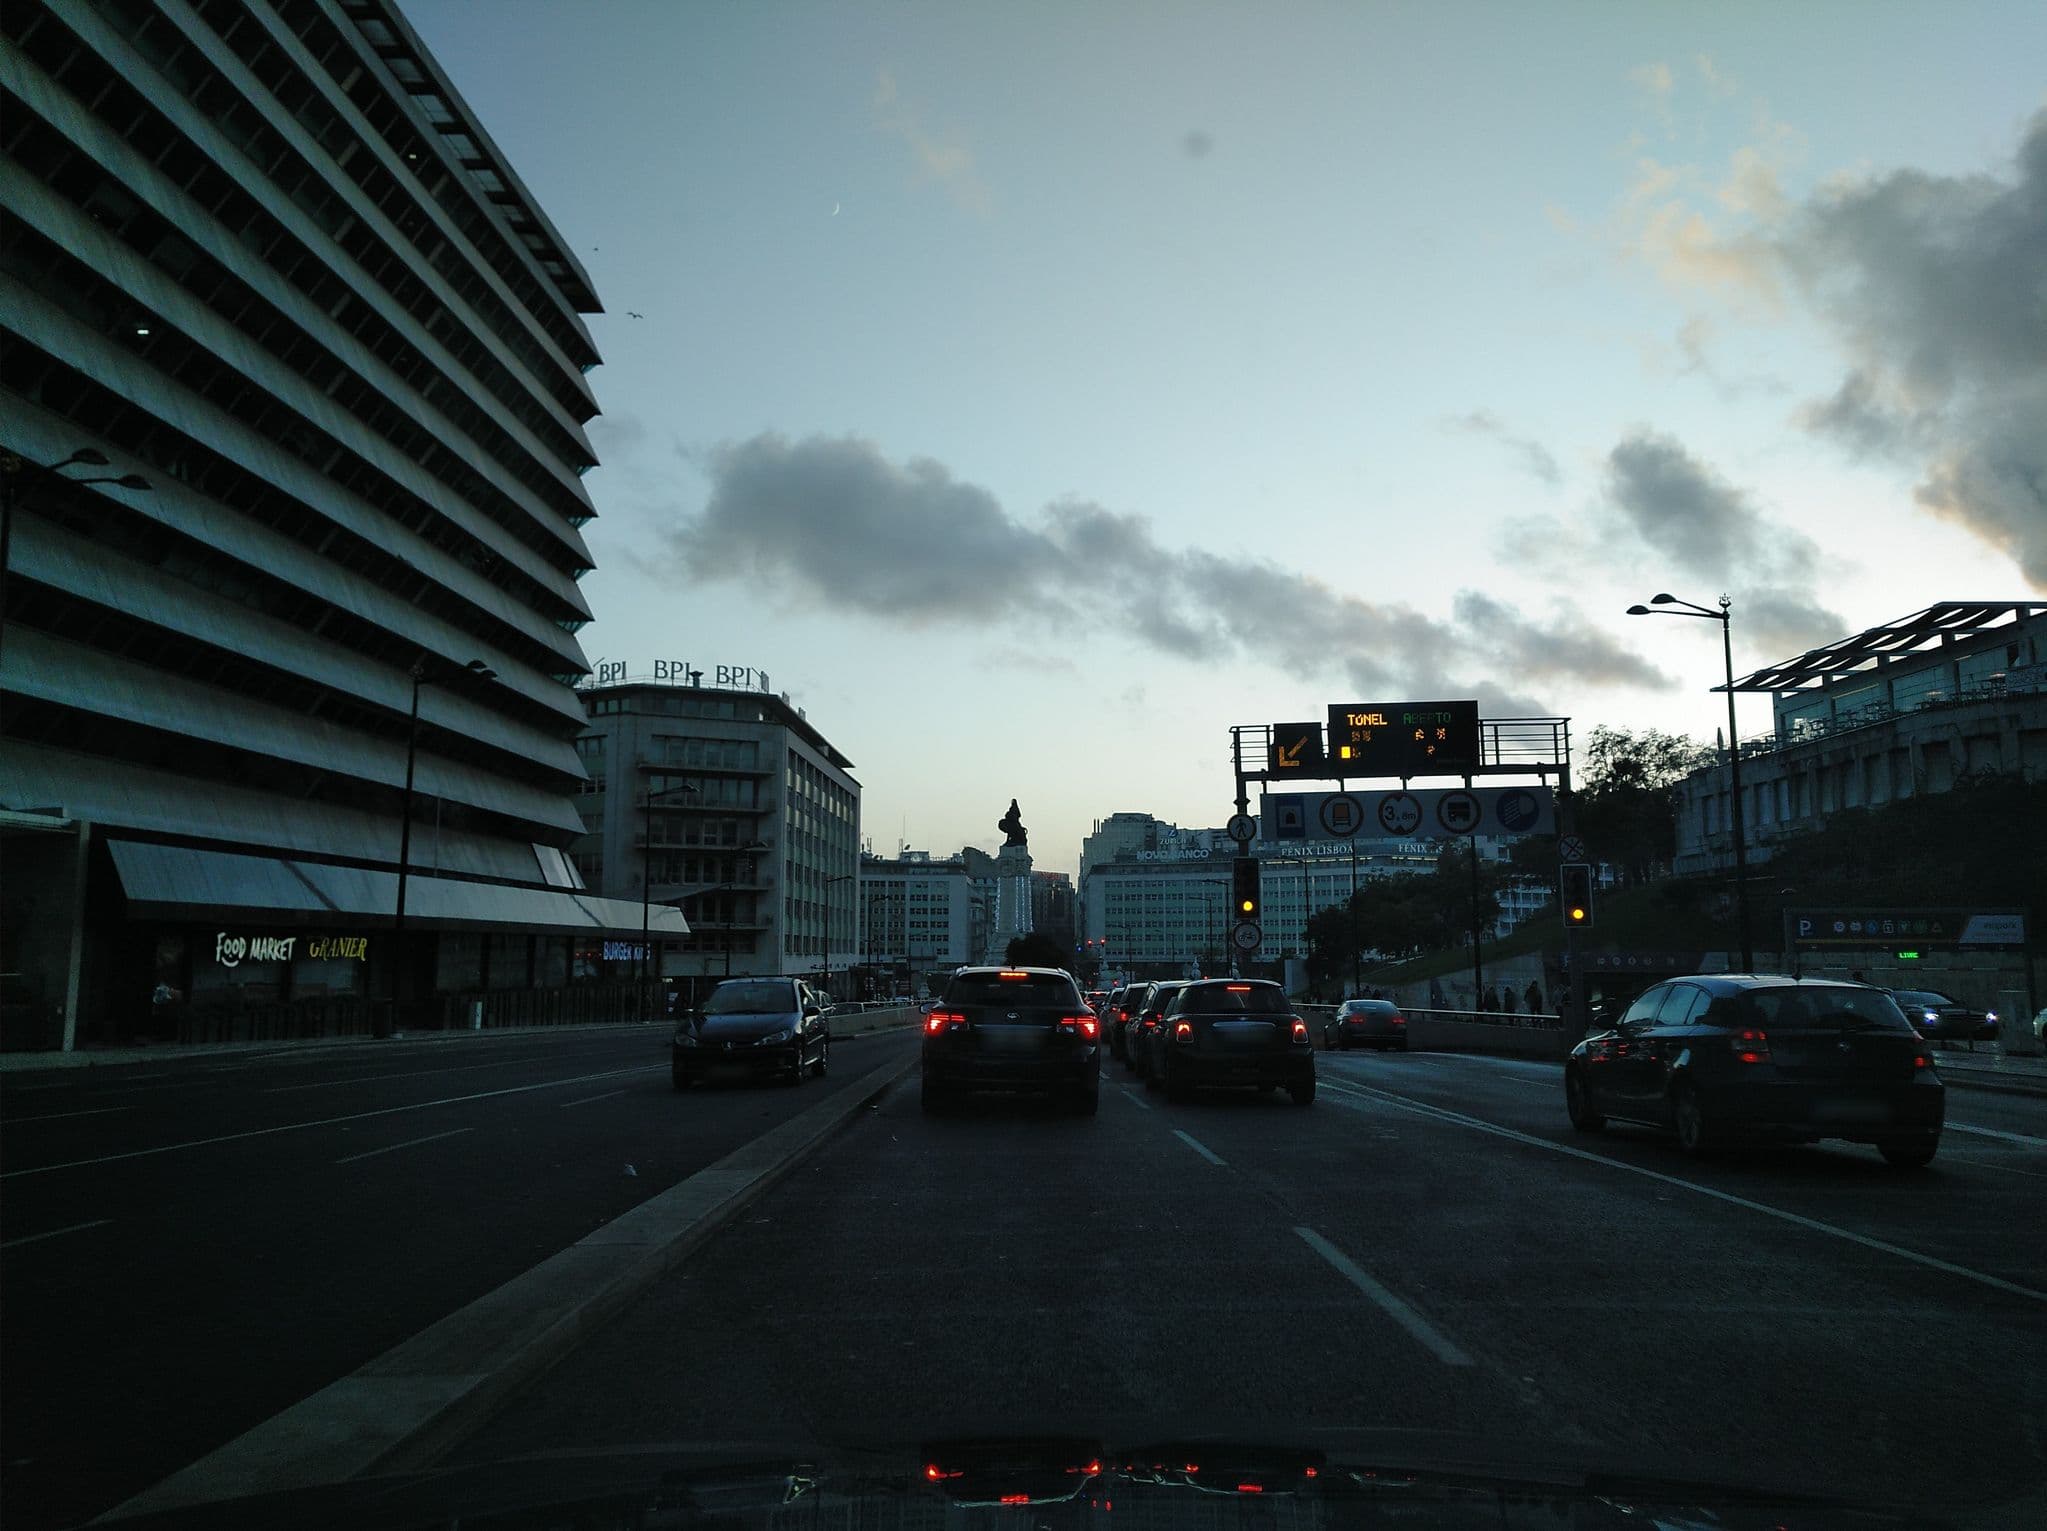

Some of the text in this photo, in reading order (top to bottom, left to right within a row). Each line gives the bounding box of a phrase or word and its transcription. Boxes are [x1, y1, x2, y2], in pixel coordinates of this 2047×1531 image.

[600, 661, 627, 682] BPI
[655, 659, 690, 681] BPI
[716, 665, 750, 686] BPI
[1317, 845, 1354, 855] LISBOA
[216, 931, 297, 967] FOOD MARKET
[307, 937, 368, 962] GRANIER
[603, 940, 632, 960] BURGER
